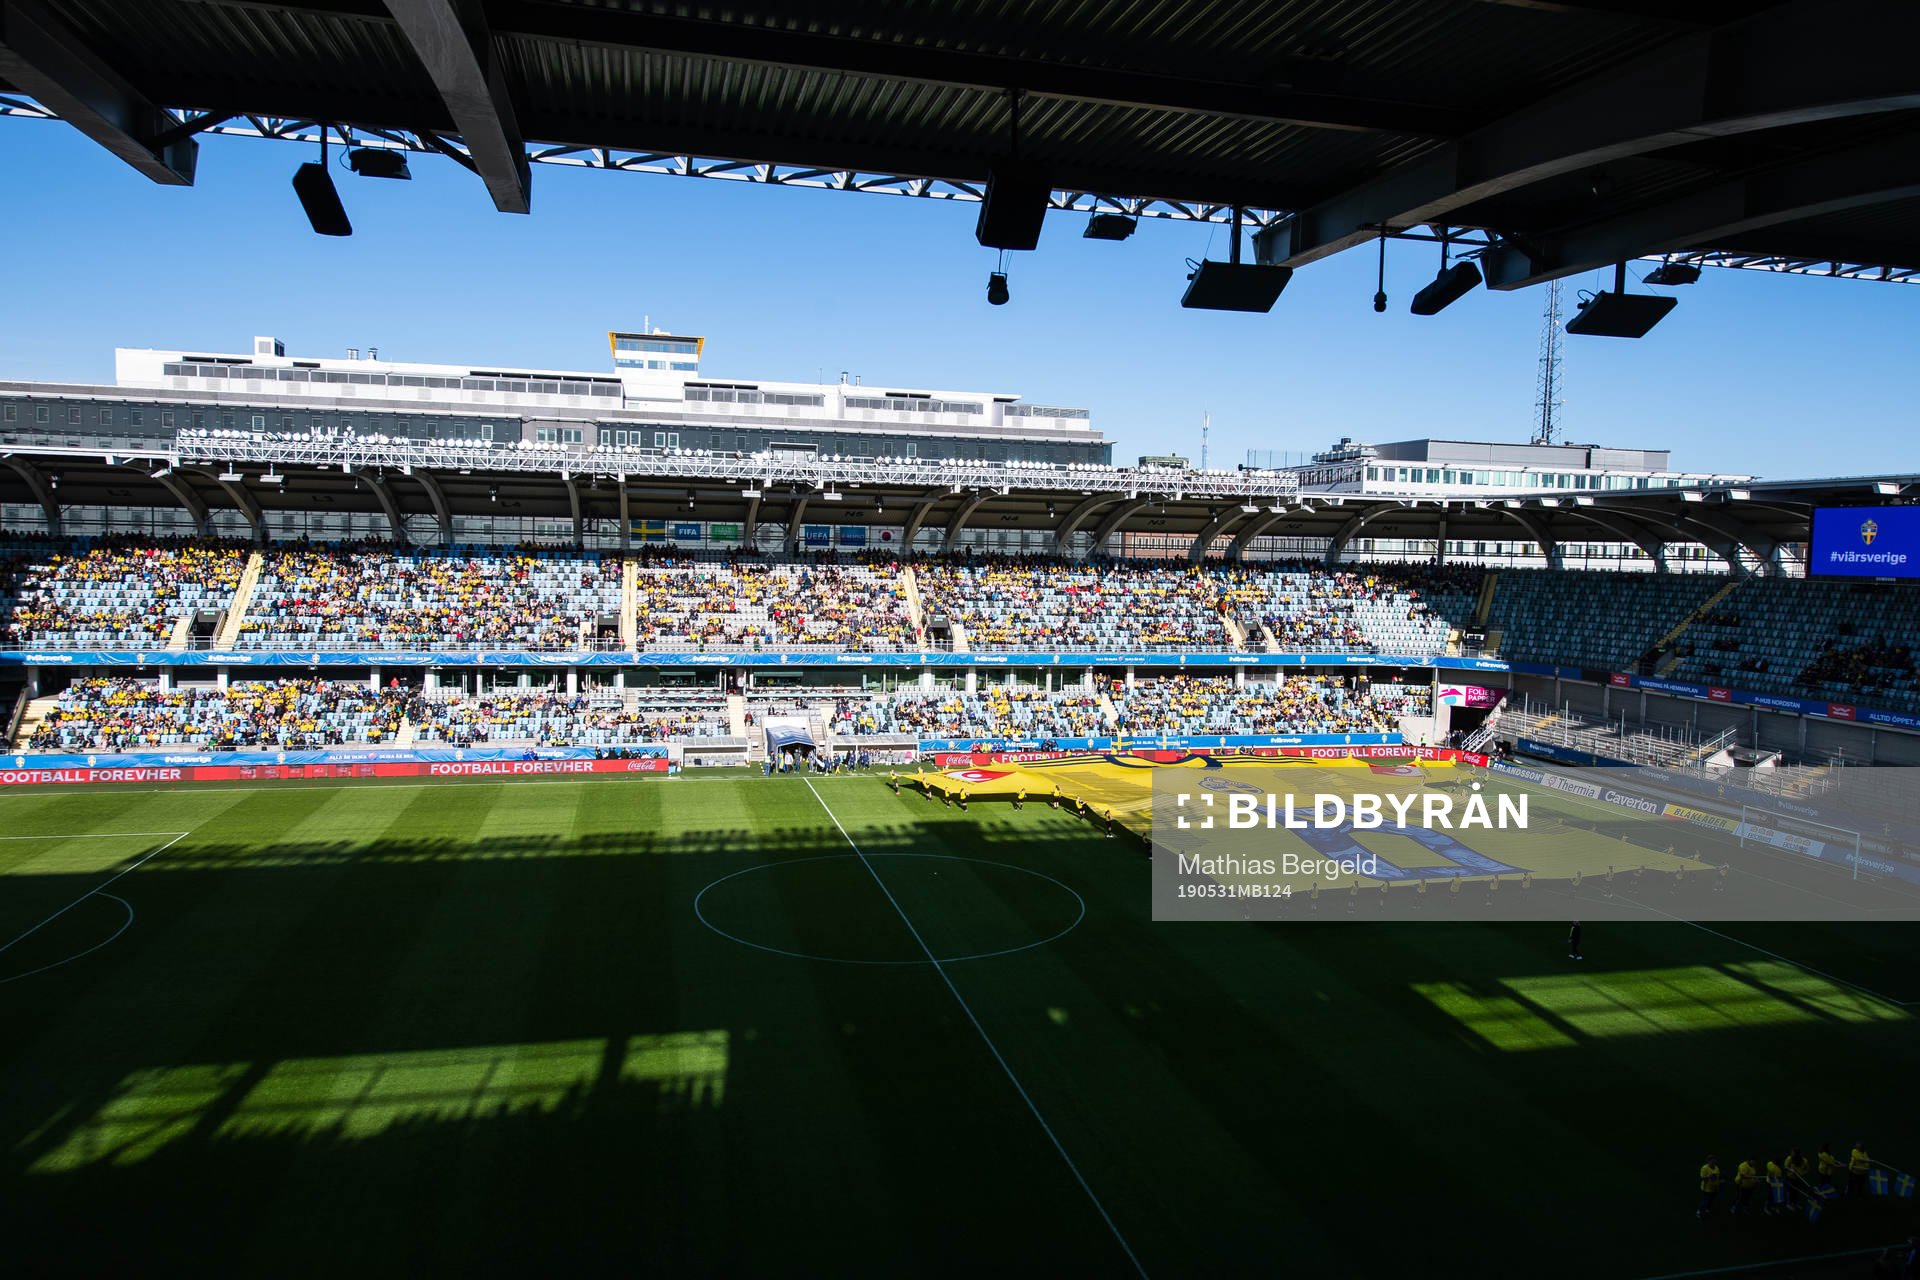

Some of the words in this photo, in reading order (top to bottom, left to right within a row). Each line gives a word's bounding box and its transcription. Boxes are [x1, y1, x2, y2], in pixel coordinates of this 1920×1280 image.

[678, 528, 698, 536] FIFA
[806, 531, 828, 541] UEFA
[1830, 551, 1907, 566] #viärsverige
[1468, 688, 1490, 696] FOLIE
[1468, 695, 1496, 703] PAPPER
[1868, 713, 1891, 722] ALLTID
[1311, 748, 1370, 758] FOOTBALL
[1371, 747, 1434, 758] FOREVHER
[430, 763, 511, 775] FOOTBALL
[513, 761, 593, 773] FOREVHER
[1493, 762, 1541, 781] ERLANDSSON
[0, 770, 85, 783] OOTBALL
[89, 768, 182, 781] FOREVHER
[1557, 777, 1595, 797] Thermia
[1605, 790, 1657, 814] Caverion
